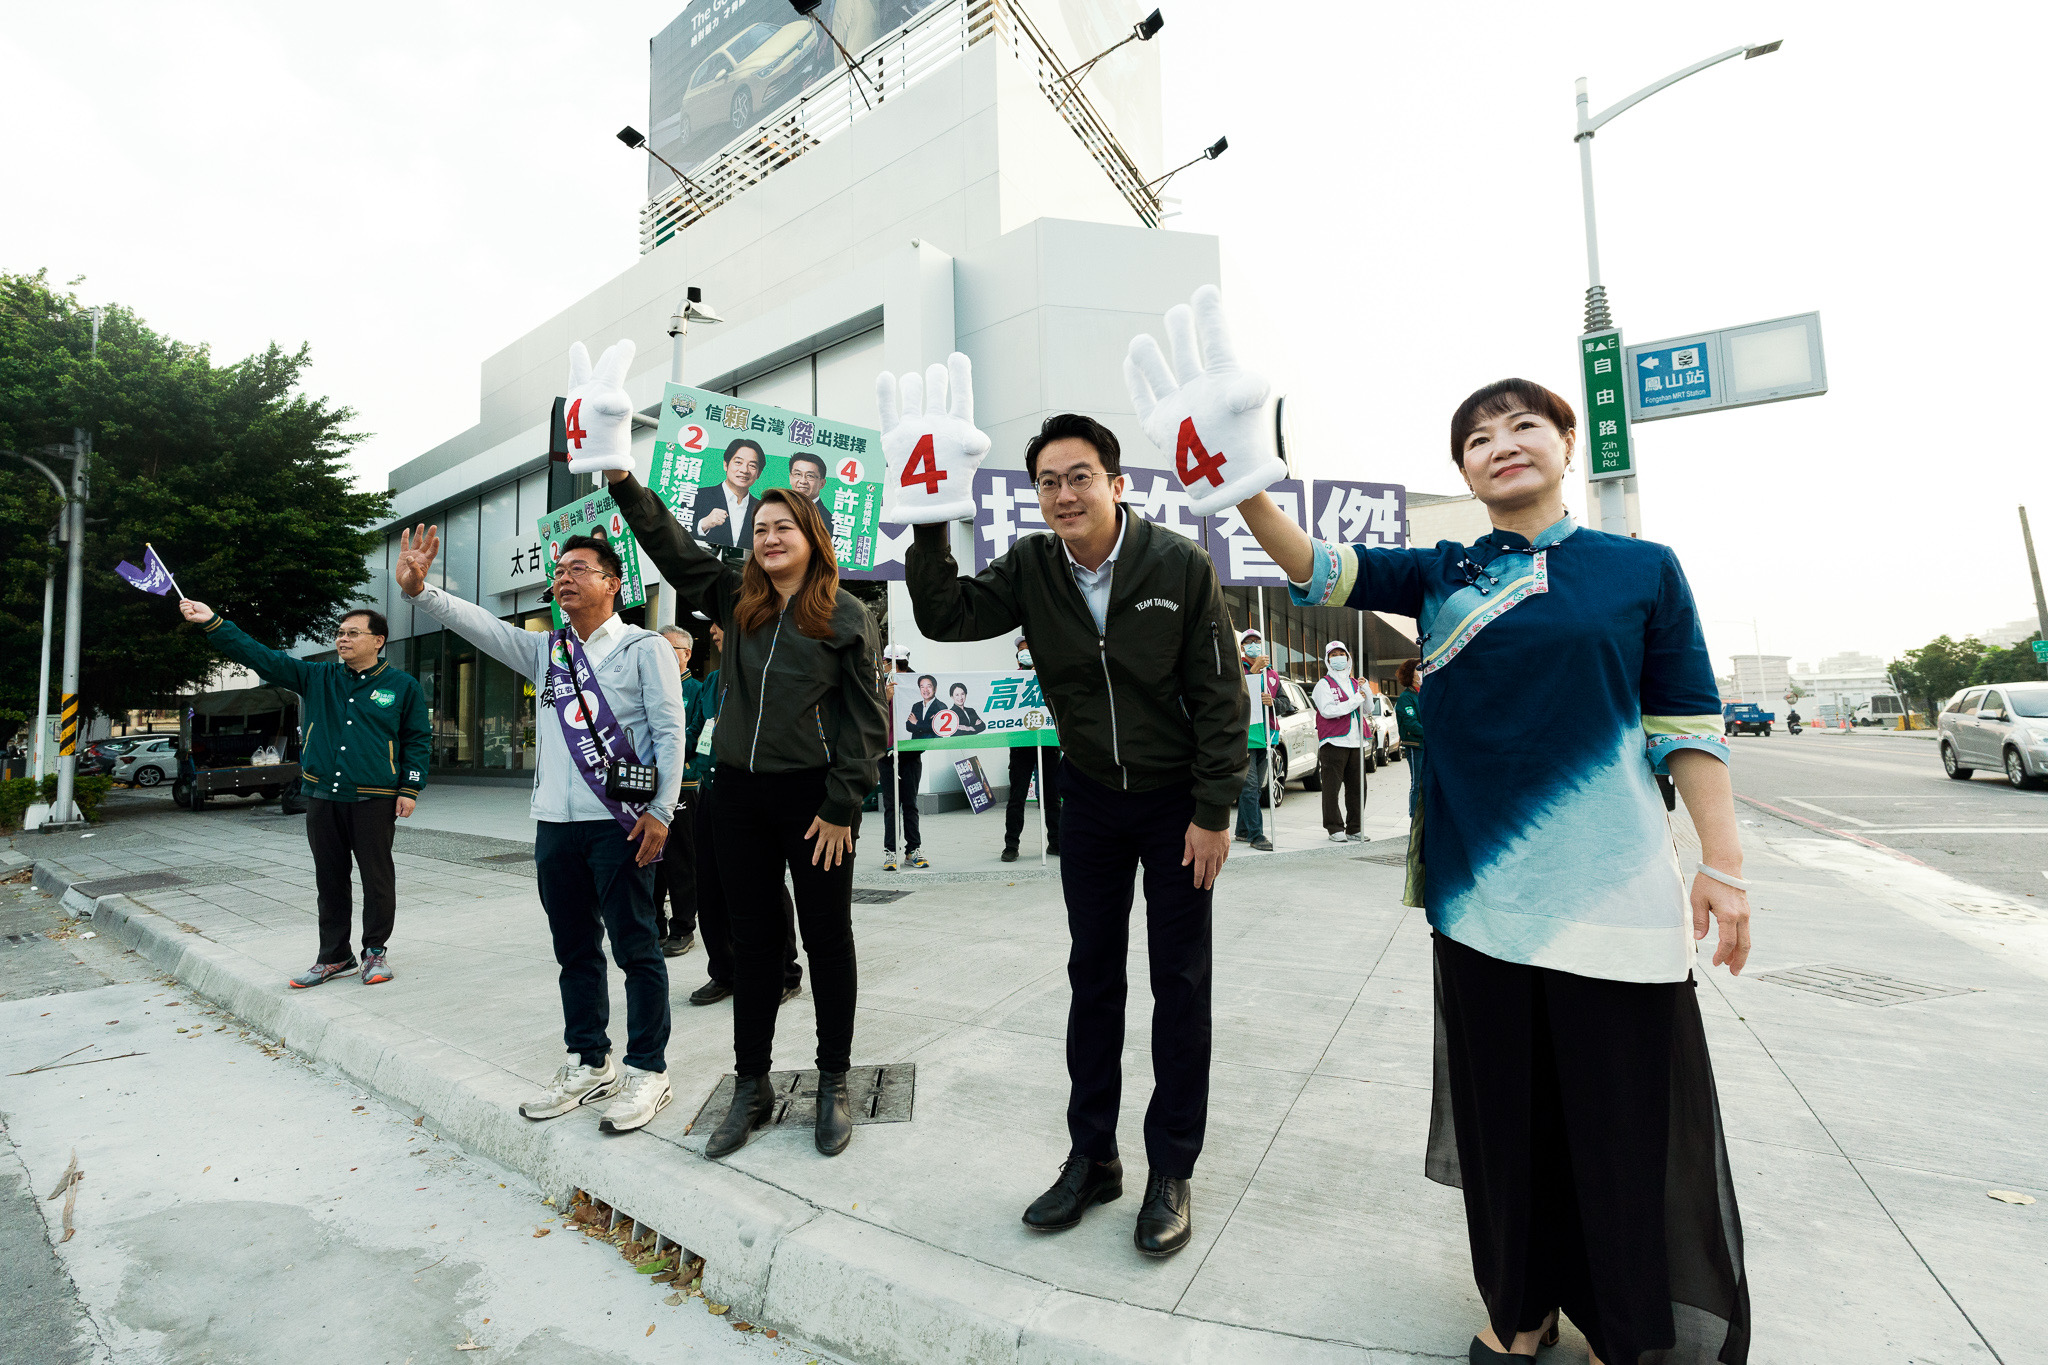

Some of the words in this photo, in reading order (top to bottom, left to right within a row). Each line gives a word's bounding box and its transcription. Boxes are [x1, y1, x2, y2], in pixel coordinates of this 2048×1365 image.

[691, 8, 711, 31] The
[1585, 343, 1594, 353] 東
[1645, 369, 1705, 391] 鳳山站
[1594, 358, 1617, 436] 自由路
[1645, 394, 1672, 404] Fongshan
[1672, 392, 1685, 400] MRT
[1686, 389, 1706, 398] Station
[566, 398, 587, 449] 4
[684, 425, 703, 450] 2
[1602, 441, 1617, 450] Zih
[1176, 416, 1227, 488] 4
[1601, 451, 1619, 459] You
[840, 460, 858, 482] 4
[900, 433, 947, 494] 4
[1603, 459, 1619, 468] Rd.
[667, 454, 703, 533] 賴清德
[612, 515, 620, 534] 4
[831, 486, 859, 564] 許智傑
[511, 542, 541, 578] 太古
[552, 542, 559, 560] 2
[1135, 598, 1153, 612] TEAM
[1153, 598, 1180, 612] TAIWAN
[940, 713, 953, 732] 2
